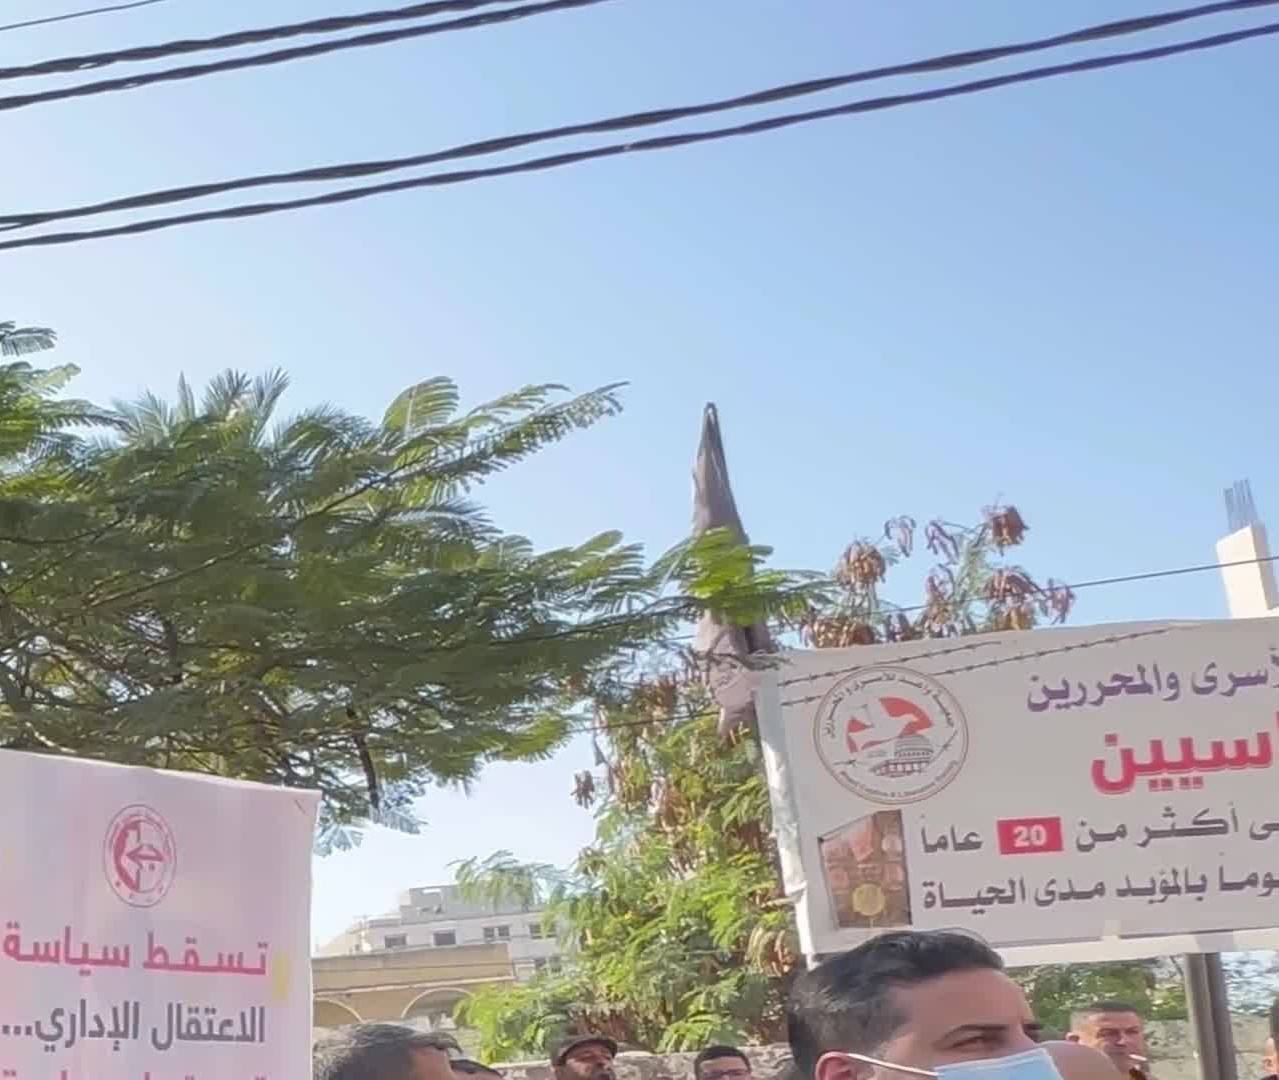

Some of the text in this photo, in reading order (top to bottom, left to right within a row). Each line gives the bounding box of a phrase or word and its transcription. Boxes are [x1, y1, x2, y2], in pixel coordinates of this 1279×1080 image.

[1027, 663, 1180, 712] والمحررين
[1092, 713, 1279, 794] سيين
[1013, 825, 1047, 848] 20
[1075, 819, 1128, 852] من
[1136, 801, 1239, 848] أكثر
[922, 875, 1026, 915] الحياة
[1034, 876, 1106, 907] مدى
[1116, 865, 1208, 904] بالمؤبد
[2, 921, 268, 976] تسقط سياسة
[151, 1002, 266, 1051] الاعتقال
